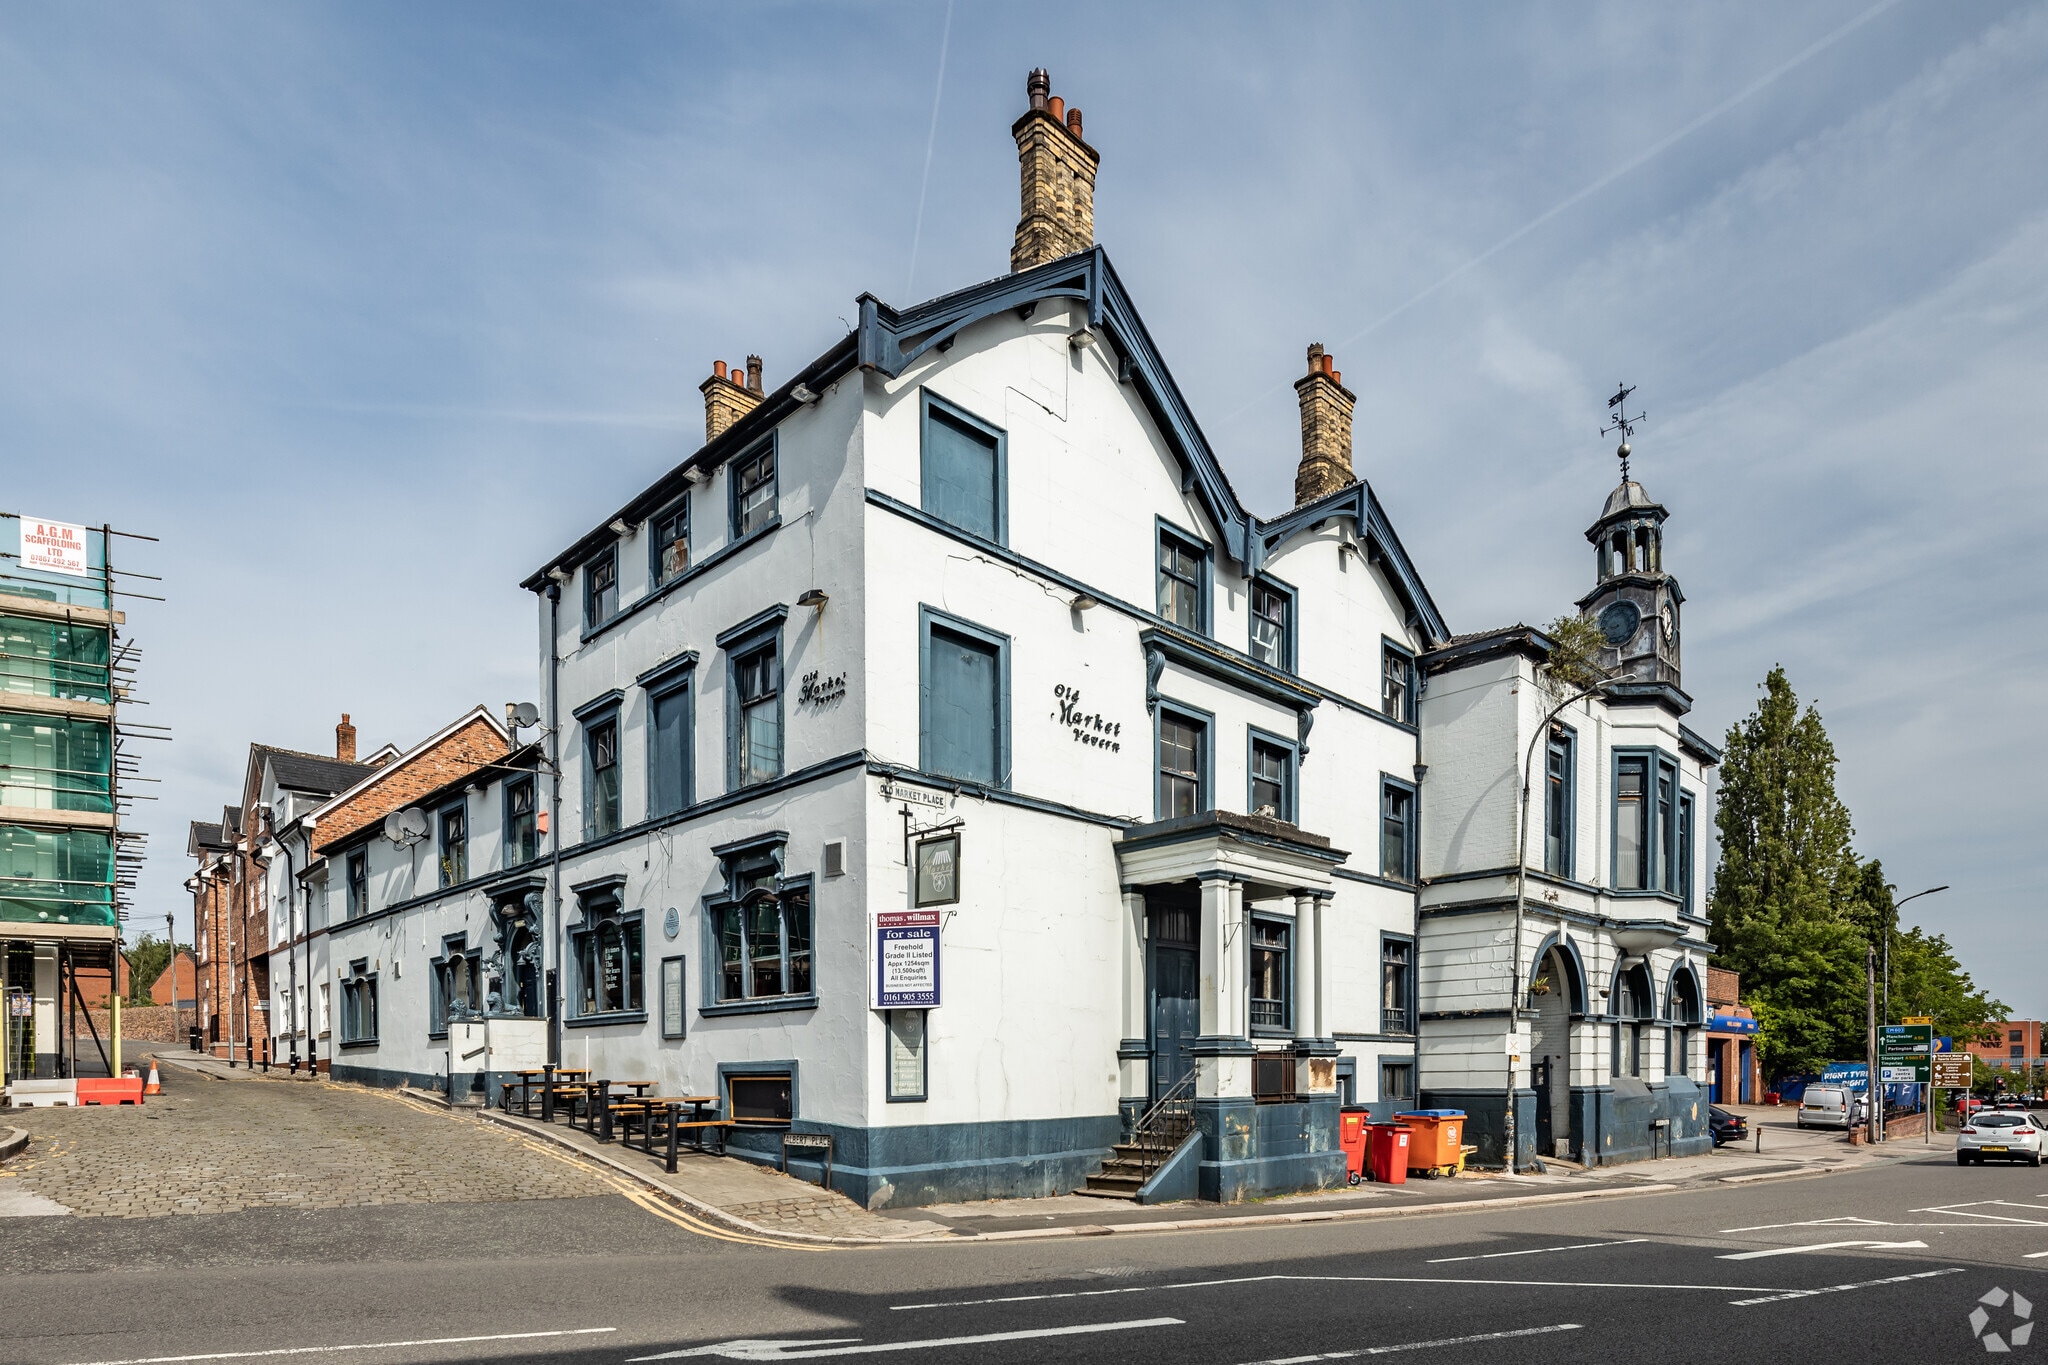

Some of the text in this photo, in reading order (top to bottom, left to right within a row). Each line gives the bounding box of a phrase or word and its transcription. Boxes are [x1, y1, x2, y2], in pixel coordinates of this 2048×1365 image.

[37, 524, 73, 541] A.G.M
[25, 534, 82, 551] SCAFFOLDING
[47, 548, 63, 557] LTD
[53, 557, 66, 565] 492
[67, 559, 80, 567] 567
[802, 670, 819, 683] Old
[1054, 684, 1080, 704] Old
[1052, 700, 1121, 737] Market
[1073, 728, 1120, 753] Tavern
[880, 785, 944, 806] OLD MARKET PLACE
[907, 913, 936, 921] willmax
[886, 929, 931, 939] for sale
[883, 993, 901, 1001] 0161
[917, 992, 934, 1000] 3555
[1824, 1072, 1848, 1080] RIGHT
[785, 1136, 831, 1146] ALBERT PLACE
